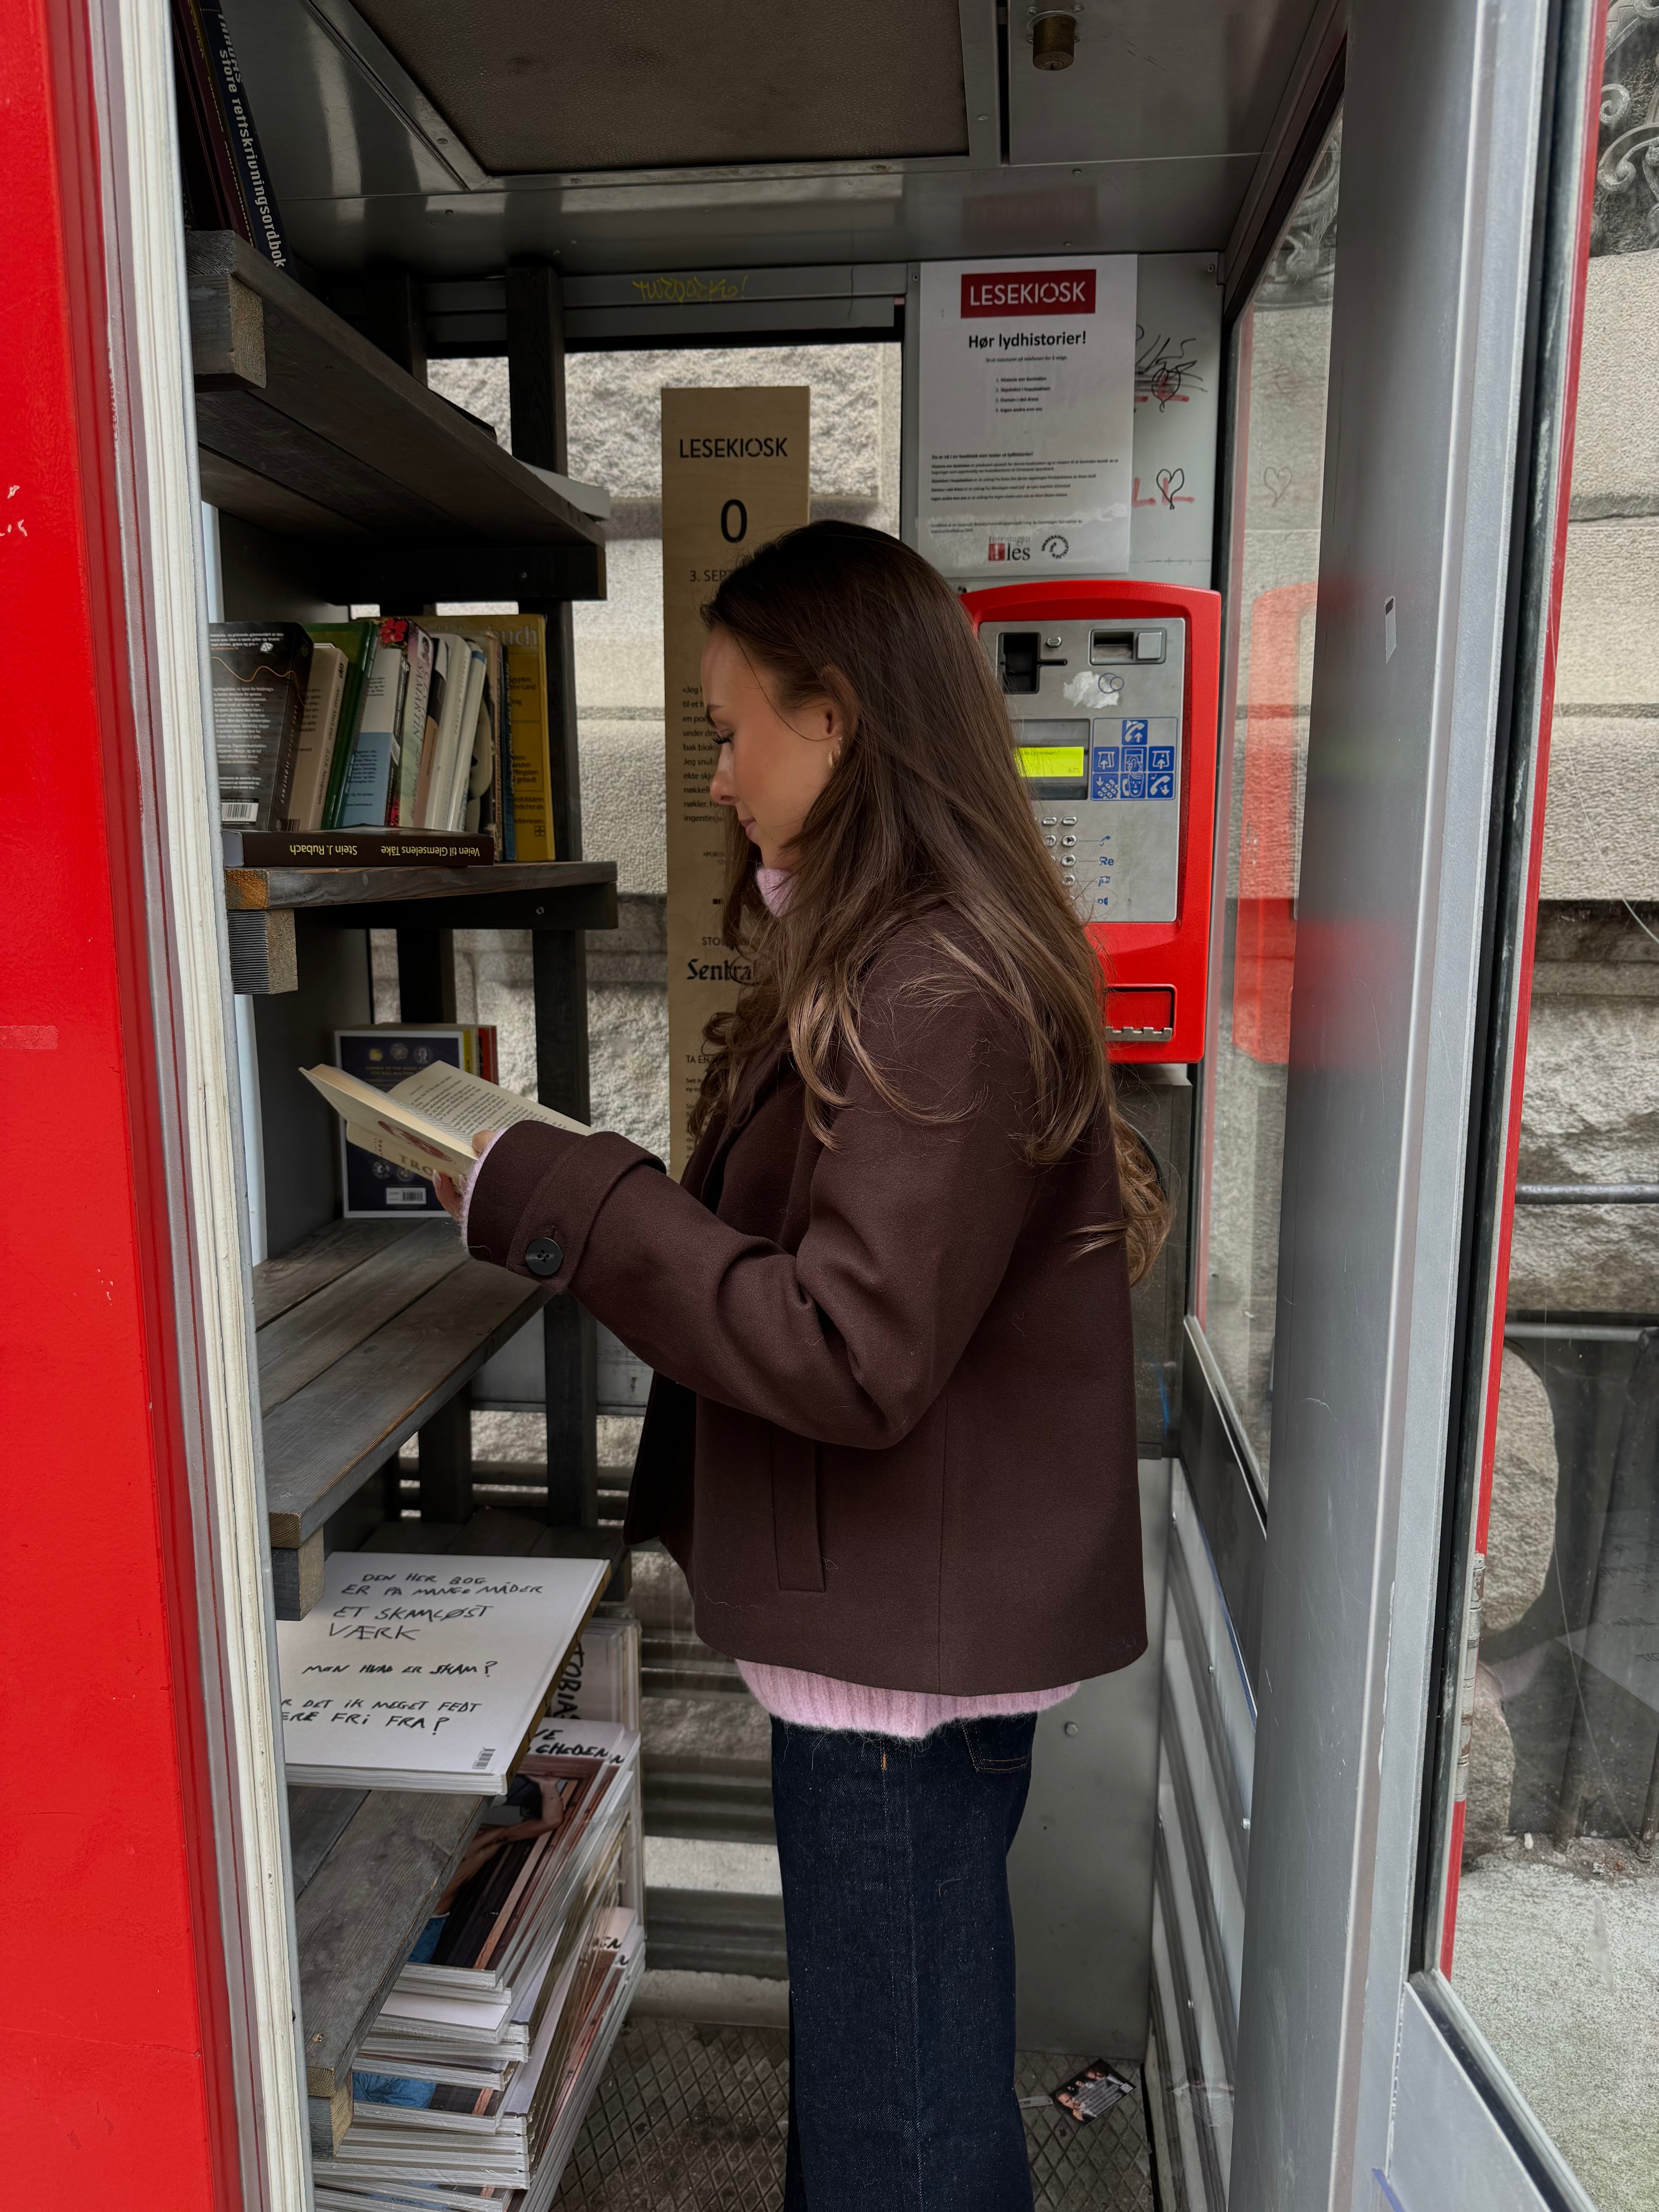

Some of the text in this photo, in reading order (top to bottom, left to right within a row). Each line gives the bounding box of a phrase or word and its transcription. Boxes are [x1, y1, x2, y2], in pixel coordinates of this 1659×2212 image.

[220, 49, 288, 268] store rettskrivningsordbok
[970, 281, 1086, 306] LESEKIOSK
[969, 330, 1087, 350] Hør lydhistorier!
[680, 438, 788, 458] LESEKIOSK
[690, 570, 700, 582] 3.
[494, 625, 538, 646] uch
[413, 663, 424, 738] SAMARTIN
[684, 758, 696, 766] Jeg
[290, 845, 357, 855] Stein J. Rubach
[381, 845, 401, 856] Tåke
[402, 846, 448, 857] Glemselens
[459, 847, 480, 857] Veien
[1099, 857, 1114, 866] Re
[686, 1055, 696, 1063] TA
[362, 1573, 487, 1584] DEN HER BOG
[341, 1585, 371, 1595] ER
[476, 1581, 543, 1594] MÅDER
[333, 1604, 495, 1622] ET SKAMLØST
[328, 1622, 421, 1640] VÆRK
[302, 1664, 350, 1674] MON
[303, 1700, 334, 1709] DET
[372, 1701, 429, 1710] MEGET
[437, 1702, 482, 1712] FEDT
[282, 1712, 319, 1722] ERE
